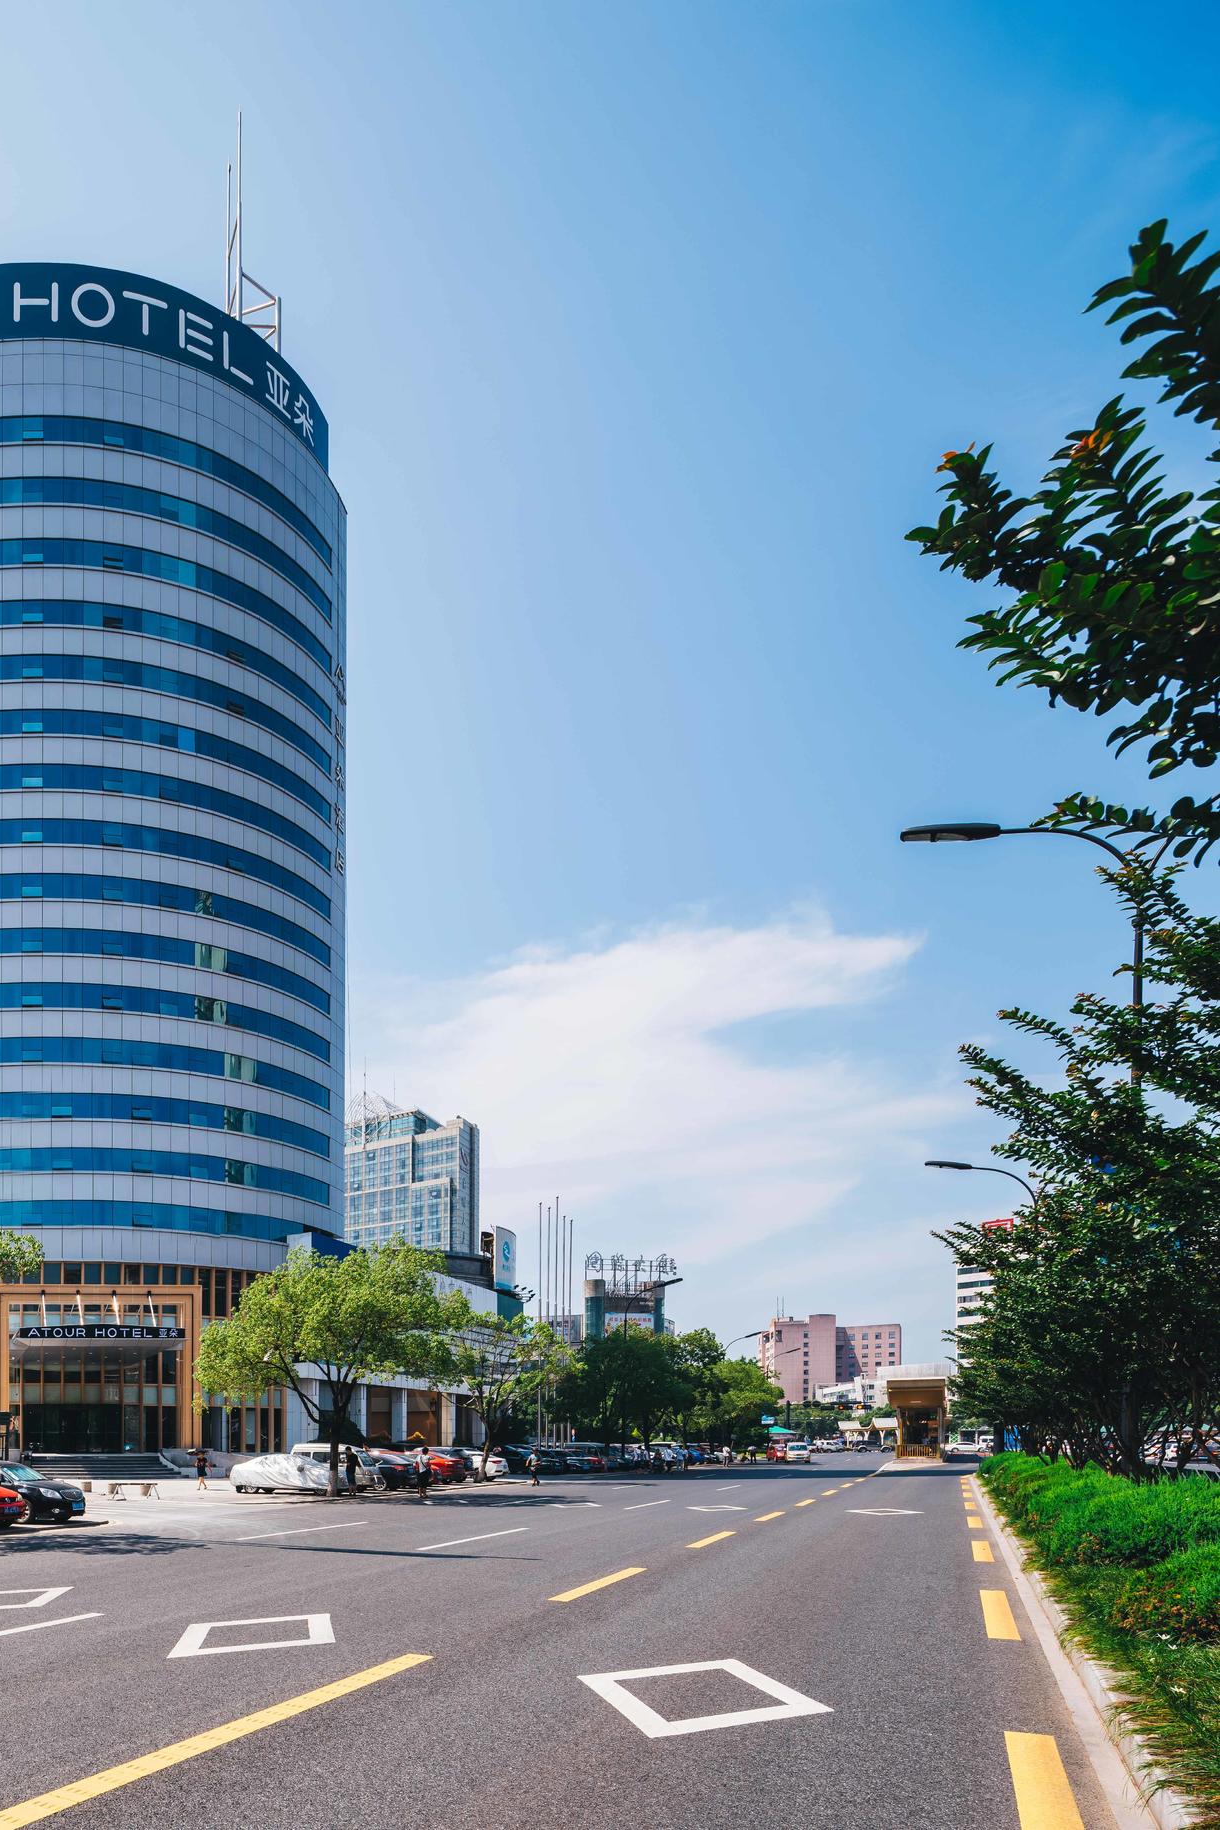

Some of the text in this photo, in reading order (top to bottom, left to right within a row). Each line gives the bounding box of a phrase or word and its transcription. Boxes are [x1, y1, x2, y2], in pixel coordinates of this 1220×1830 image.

[13, 282, 253, 385] HOTEL
[265, 360, 315, 447] 亚朵
[28, 1327, 179, 1338] ATOUR HOTEL 亚朵
